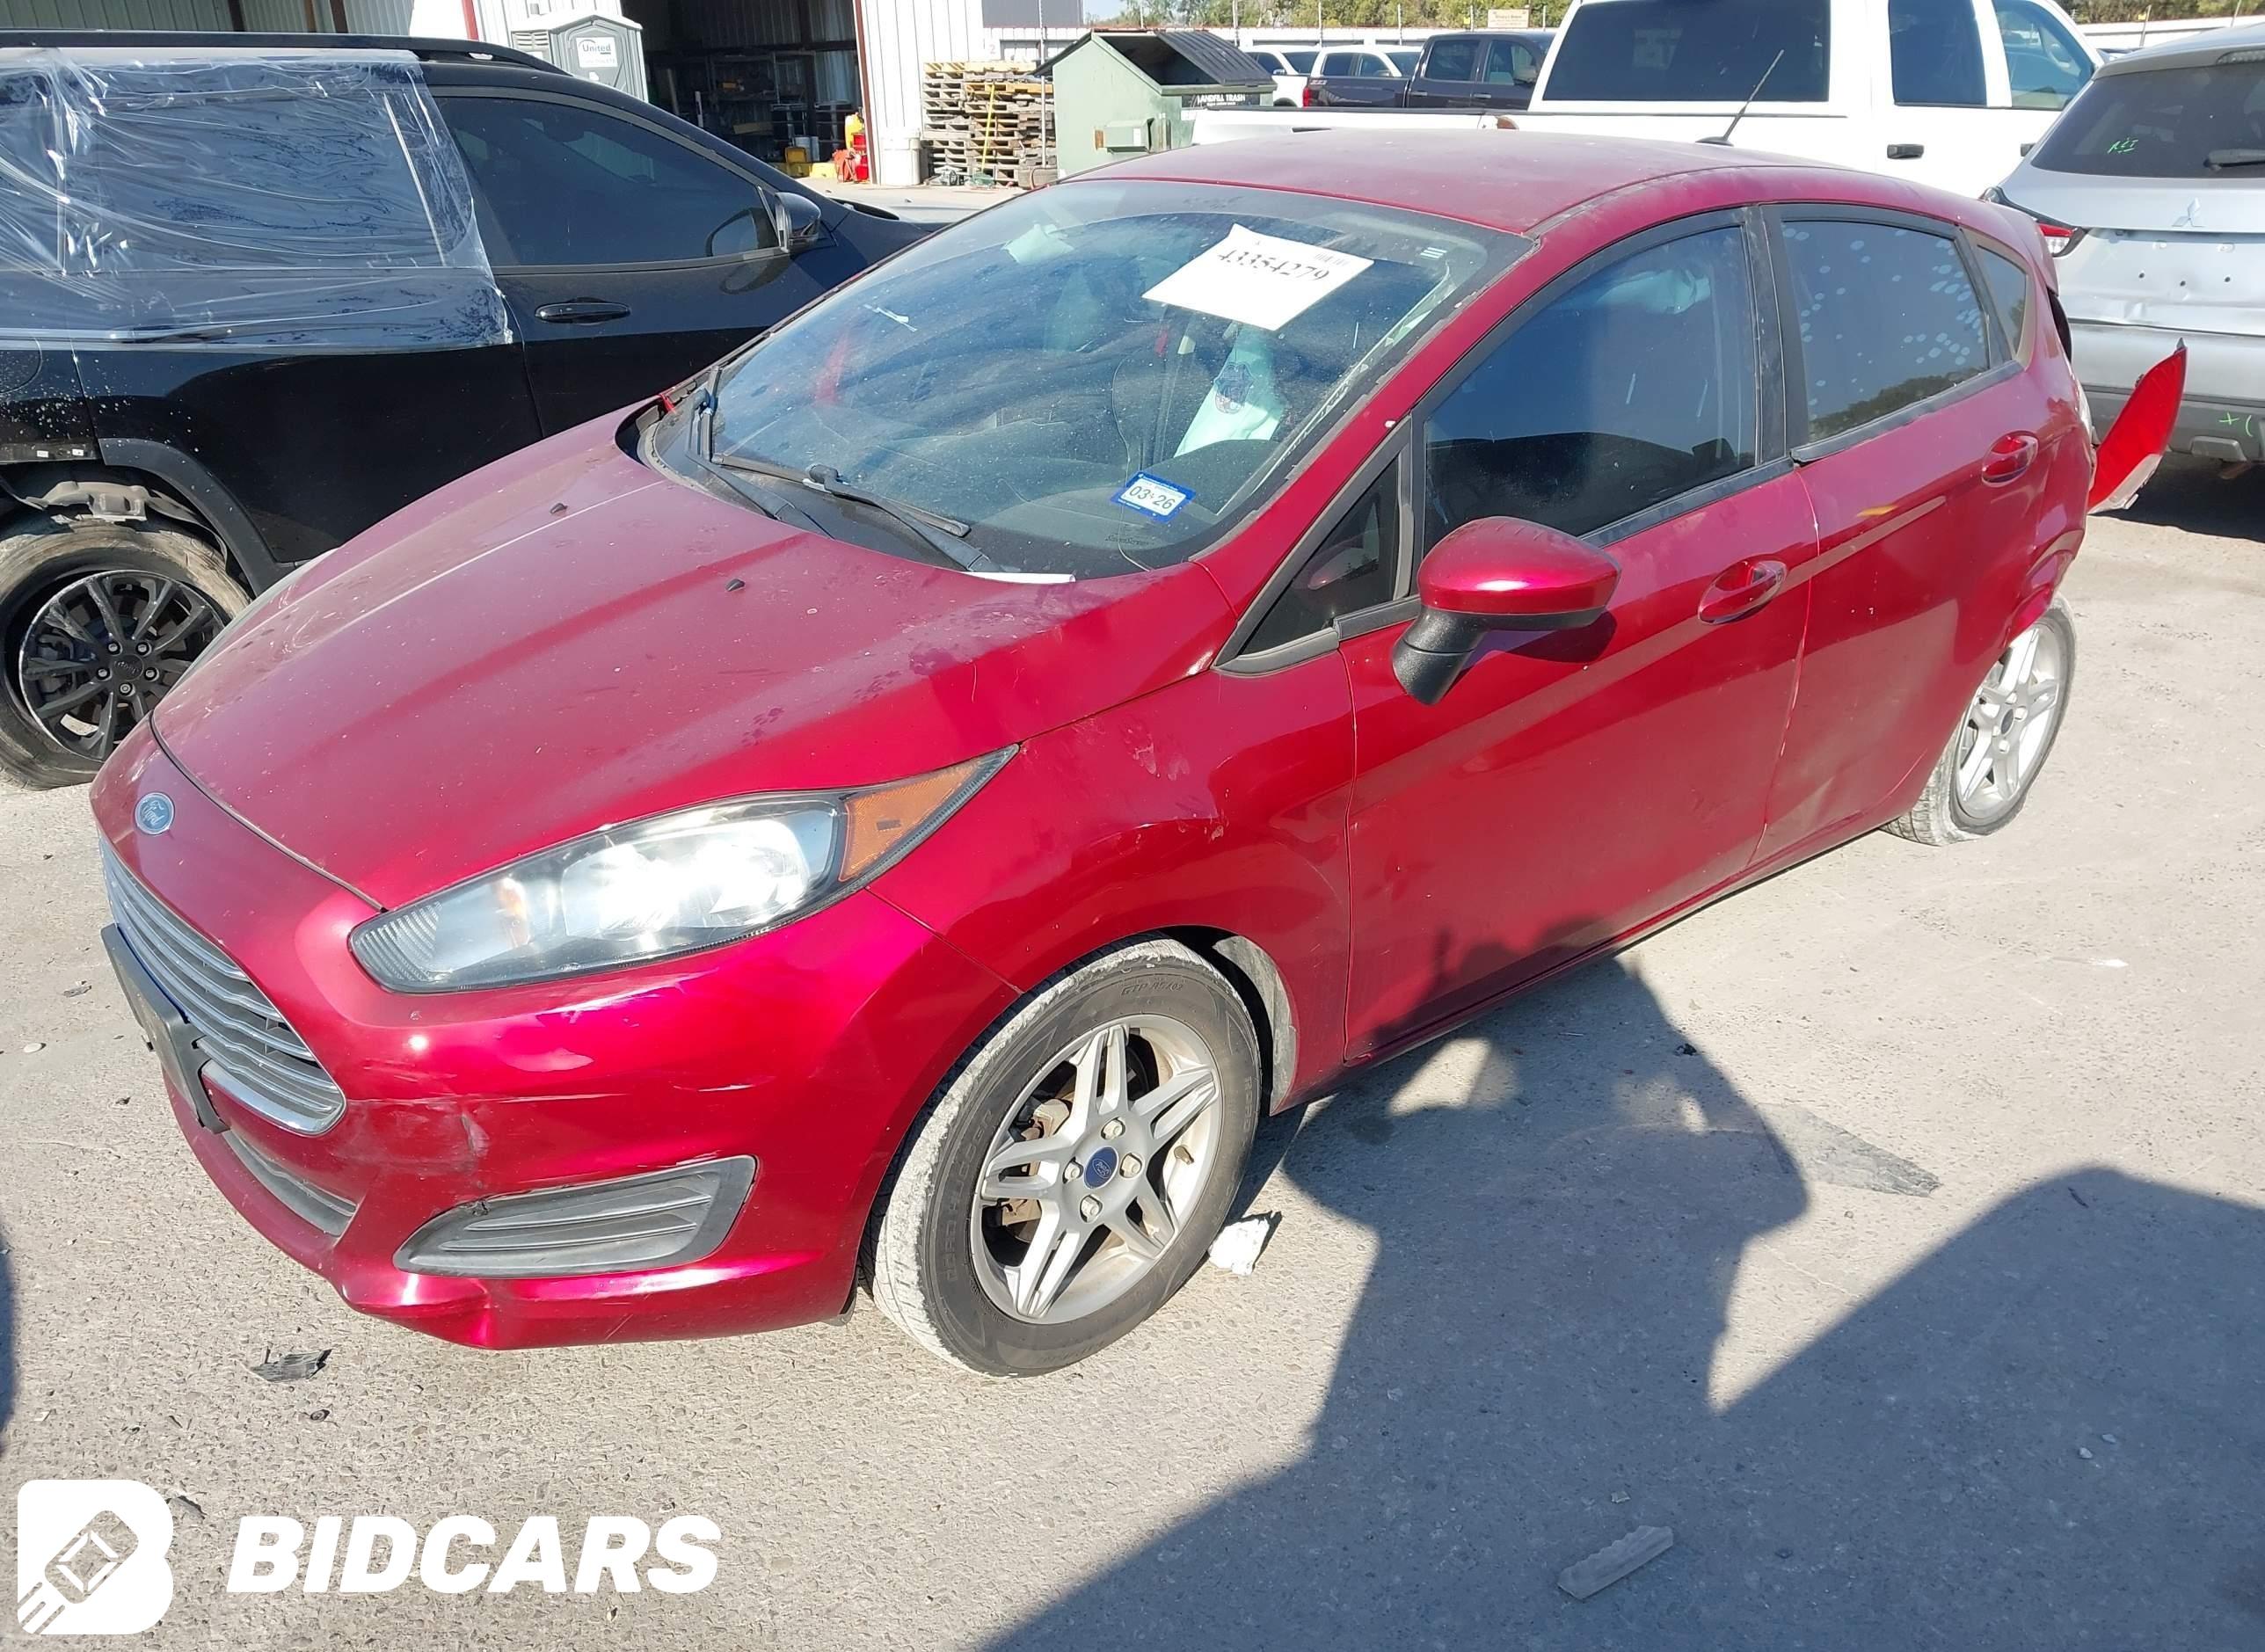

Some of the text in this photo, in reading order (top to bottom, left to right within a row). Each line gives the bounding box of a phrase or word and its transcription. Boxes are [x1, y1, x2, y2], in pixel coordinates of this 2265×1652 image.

[582, 43, 612, 53] United
[1226, 93, 1246, 102] TRASH
[1218, 250, 1329, 280] 43354279
